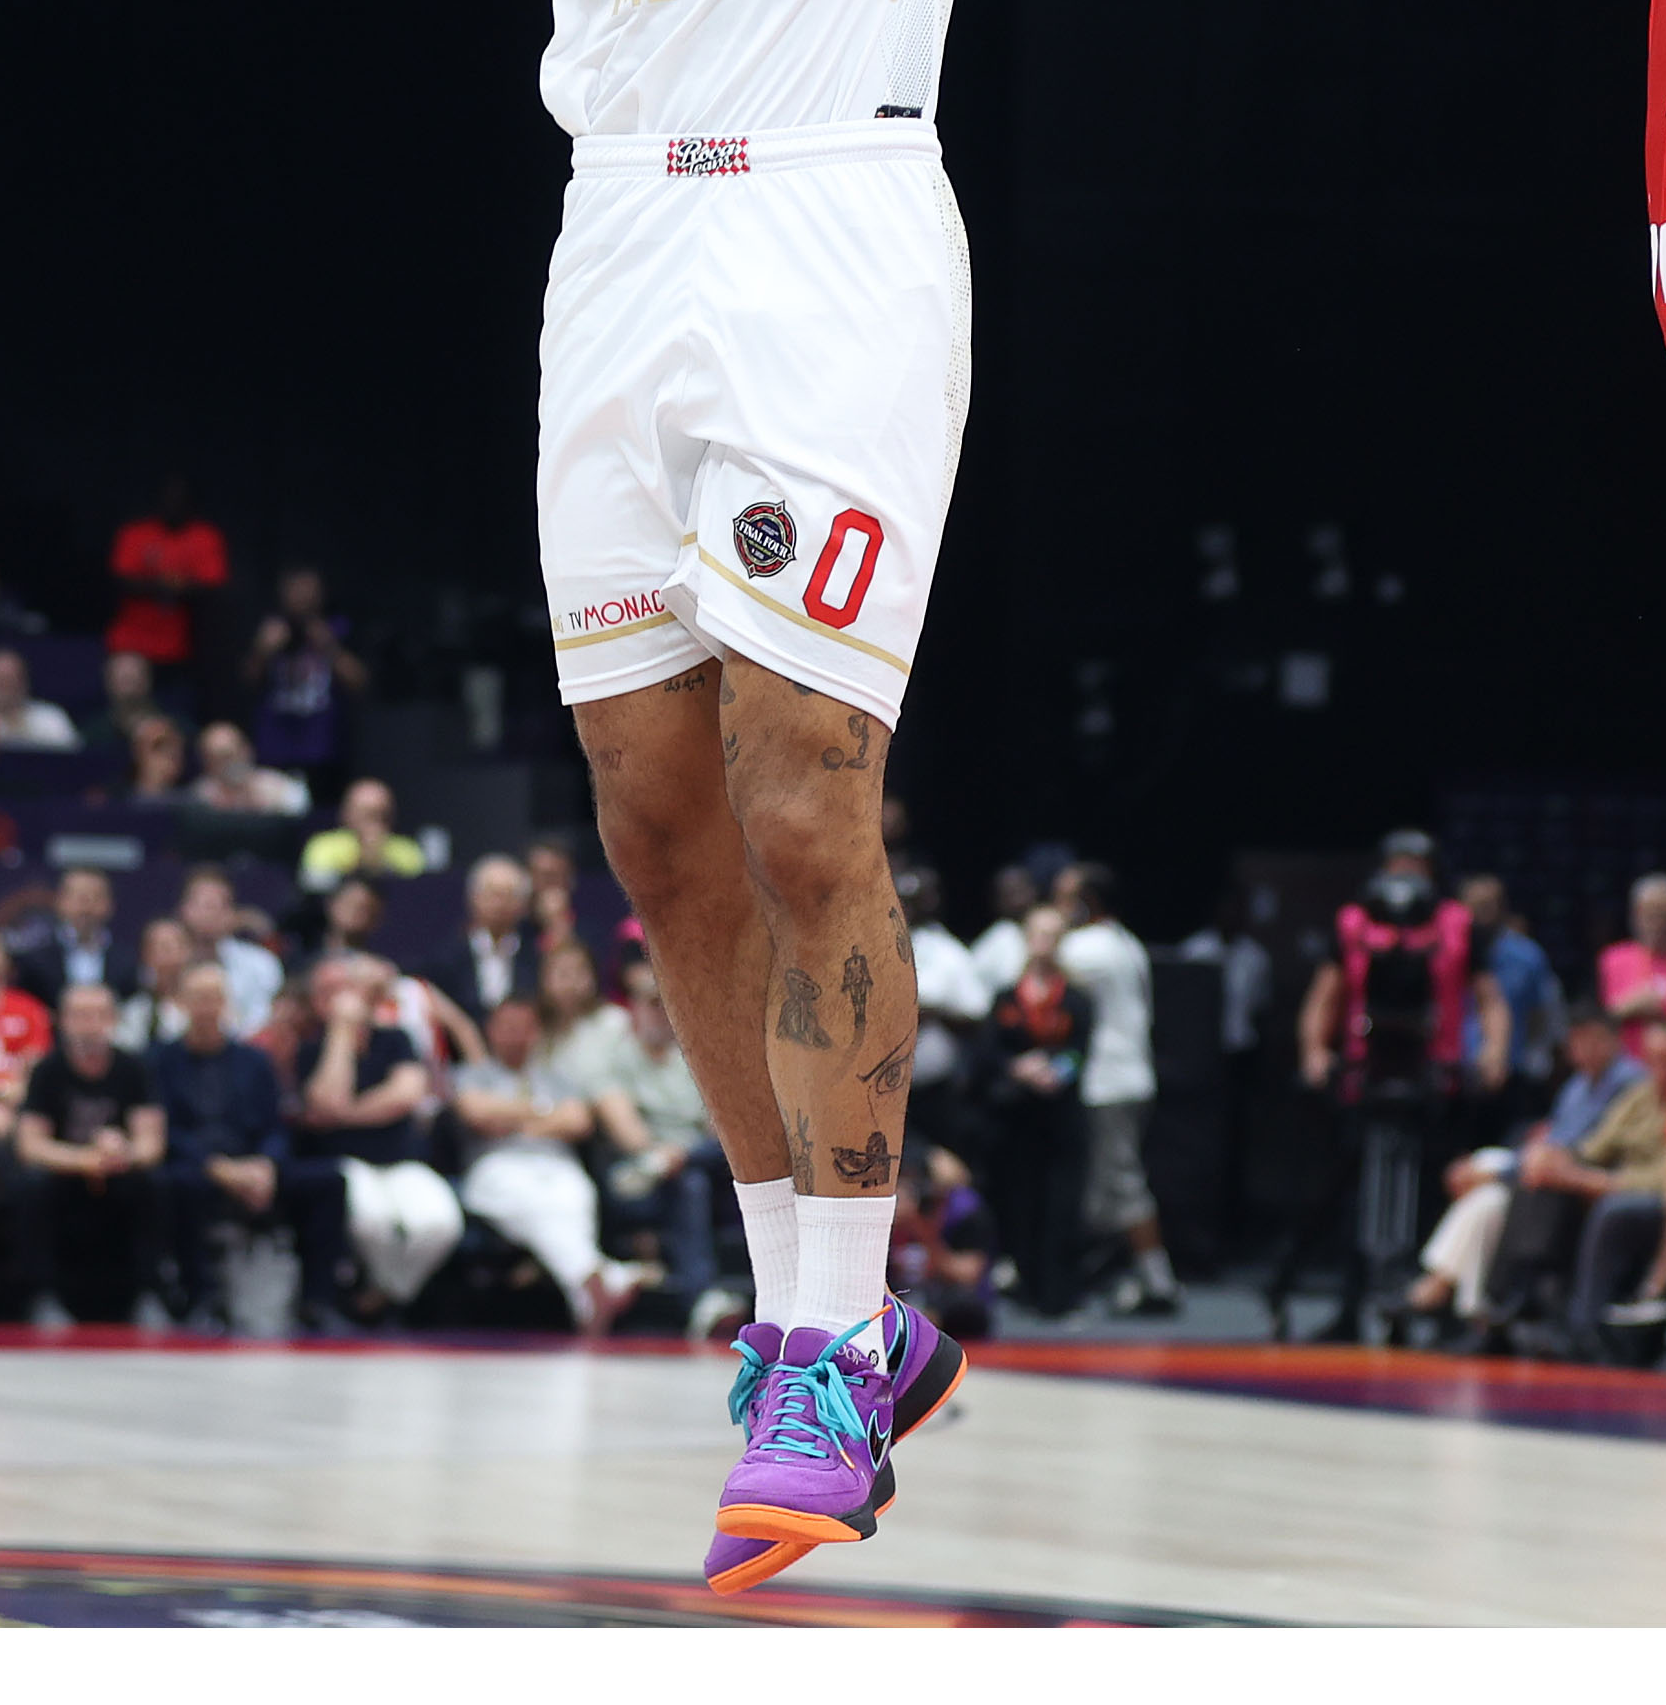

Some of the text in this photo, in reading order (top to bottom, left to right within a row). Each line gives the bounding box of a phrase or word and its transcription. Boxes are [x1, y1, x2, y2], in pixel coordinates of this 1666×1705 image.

[676, 137, 741, 168] Roca
[688, 155, 732, 177] Team
[802, 507, 885, 630] 0
[568, 610, 582, 630] TV
[584, 590, 666, 631] MONAC
